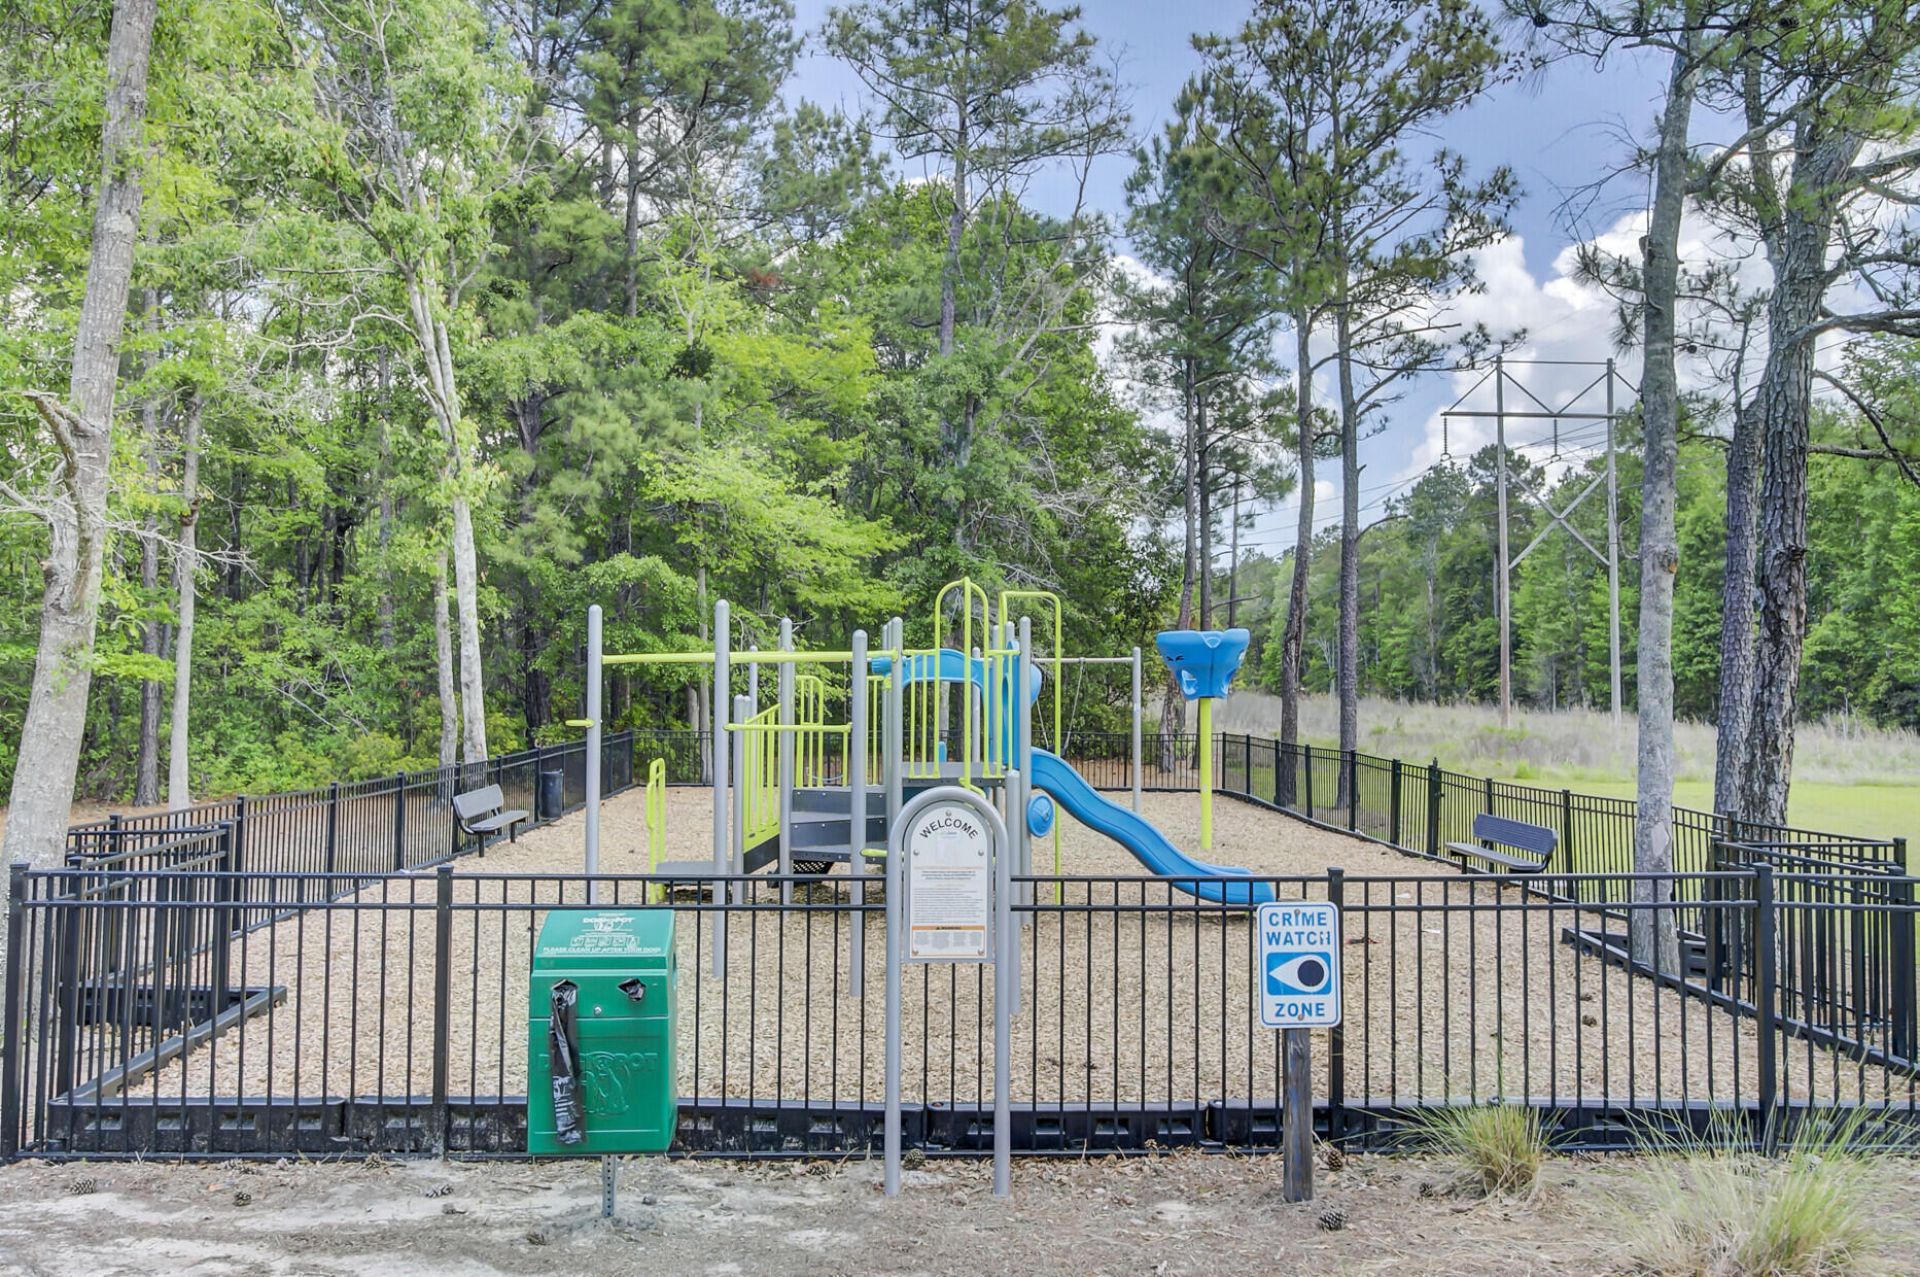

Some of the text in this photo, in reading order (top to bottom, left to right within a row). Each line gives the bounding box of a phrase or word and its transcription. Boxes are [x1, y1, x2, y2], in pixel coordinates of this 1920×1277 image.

[920, 818, 978, 840] WELCOME
[1268, 911, 1327, 926] CRIME
[1266, 931, 1331, 946] WATCH
[1275, 1002, 1325, 1017] ZONE
